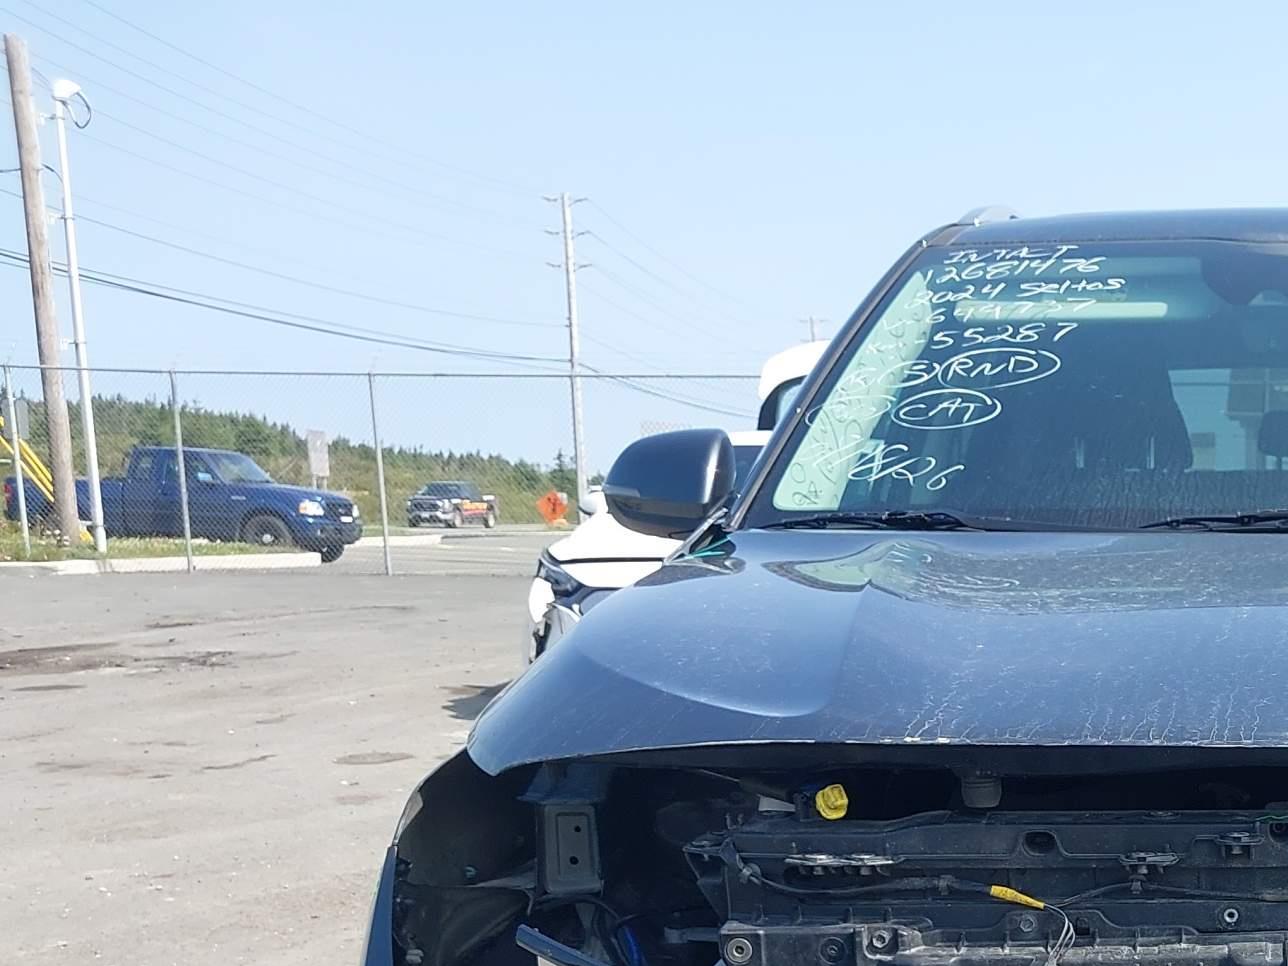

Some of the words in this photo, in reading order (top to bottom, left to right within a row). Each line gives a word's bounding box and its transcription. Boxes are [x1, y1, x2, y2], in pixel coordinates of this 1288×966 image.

[923, 256, 1107, 284] 12681476
[904, 282, 1008, 310] 2024
[946, 355, 1039, 382] RND
[899, 397, 984, 424] CAT
